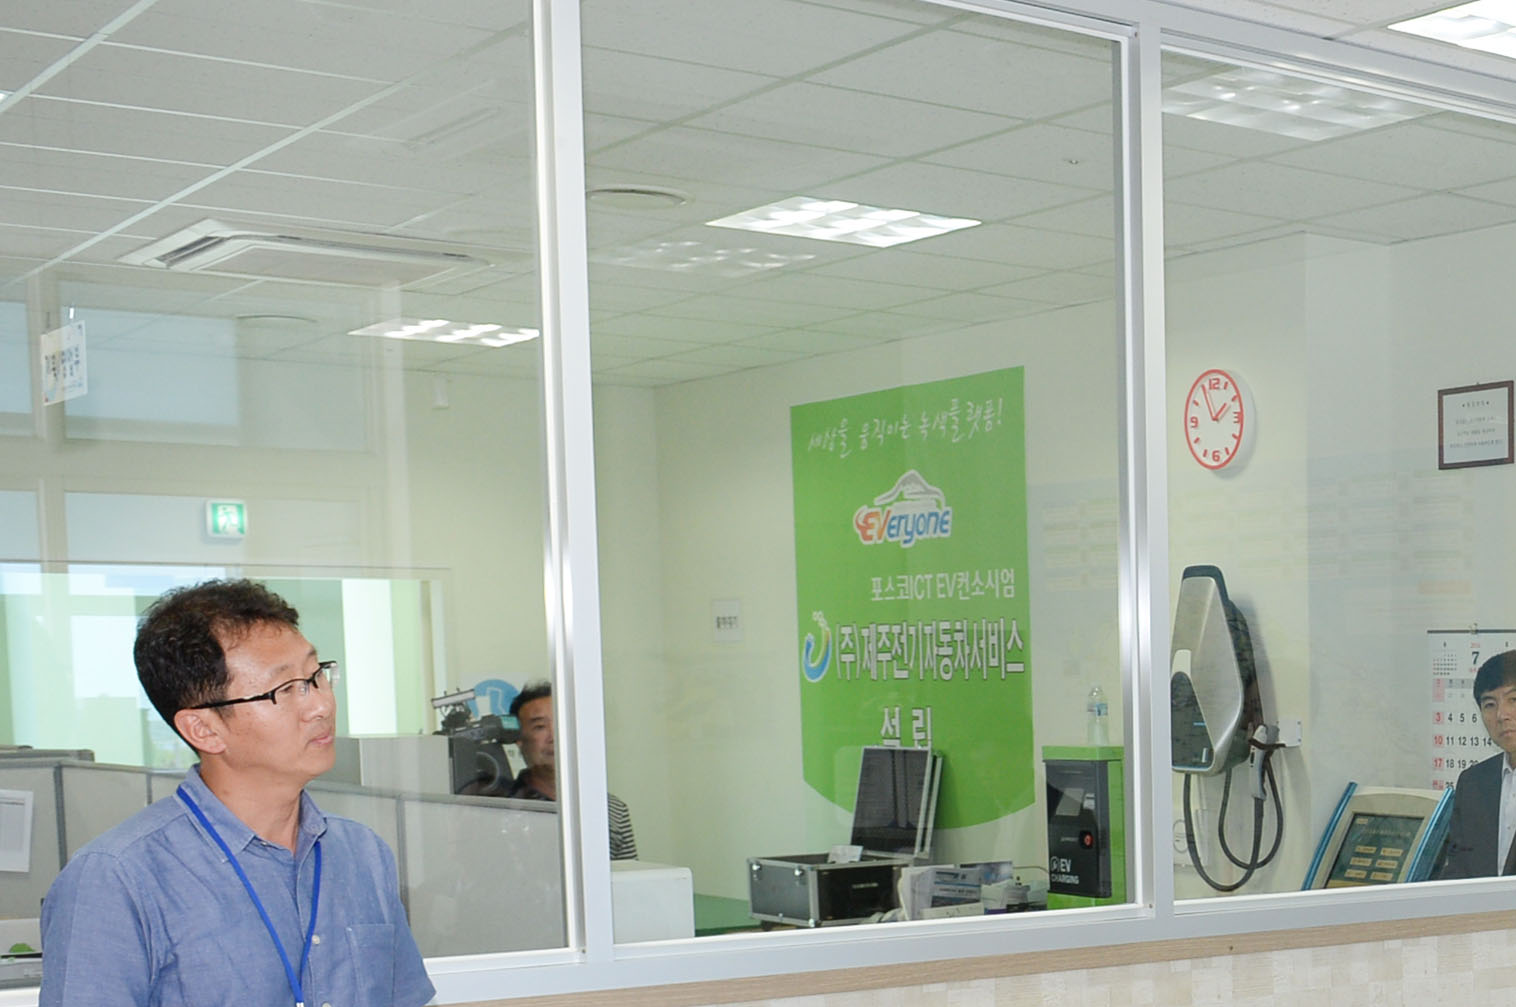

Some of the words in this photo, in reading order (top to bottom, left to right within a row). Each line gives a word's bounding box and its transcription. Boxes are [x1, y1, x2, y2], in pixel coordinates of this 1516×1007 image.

[1208, 378, 1220, 390] 12
[1190, 416, 1199, 429] 9
[1232, 411, 1242, 424] 3
[1212, 450, 1220, 462] 6
[872, 573, 933, 601] 포스코ICT
[937, 568, 1015, 599] EV컨소시엄
[835, 618, 1025, 682] (주)제주전기자동차서비스
[1471, 651, 1480, 665] 7
[1435, 712, 1442, 722] 3
[1447, 713, 1453, 722] 4
[1459, 713, 1465, 723] 5
[1471, 714, 1478, 723] 6
[1434, 736, 1443, 745] 10
[1446, 736, 1454, 746] 11
[1458, 736, 1467, 746] 12
[1470, 737, 1479, 747] 13
[1482, 738, 1492, 747] 14
[1434, 758, 1442, 768] 17
[1446, 759, 1455, 769] 18
[1457, 759, 1467, 769] 19
[1060, 859, 1072, 873] EV
